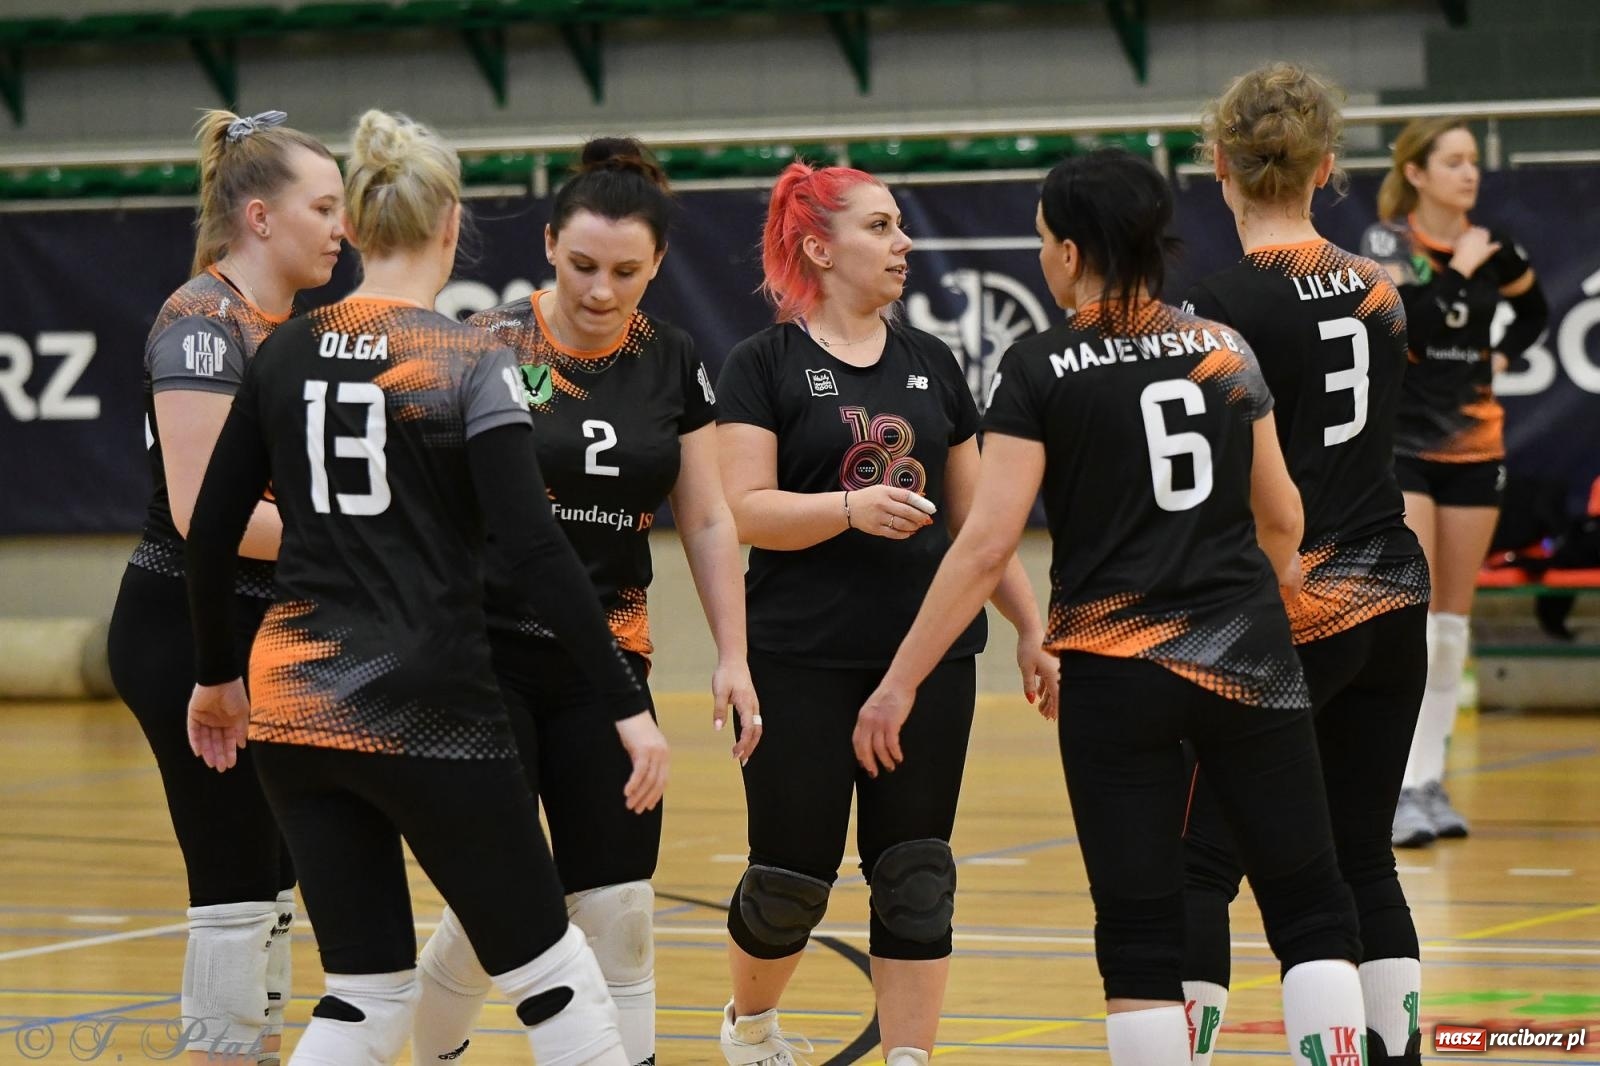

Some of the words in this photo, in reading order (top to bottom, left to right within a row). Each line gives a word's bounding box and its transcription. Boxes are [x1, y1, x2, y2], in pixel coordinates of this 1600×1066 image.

[1293, 267, 1366, 301] LILKA
[319, 331, 388, 360] OLGA
[1049, 329, 1221, 378] MAJEWSKA
[0, 331, 100, 422] RZ
[1317, 316, 1370, 447] 3
[303, 379, 391, 516] 13
[582, 419, 620, 477] 2
[1140, 378, 1213, 511] 6
[551, 503, 633, 531] Fundacja
[1329, 1026, 1357, 1054] TK
